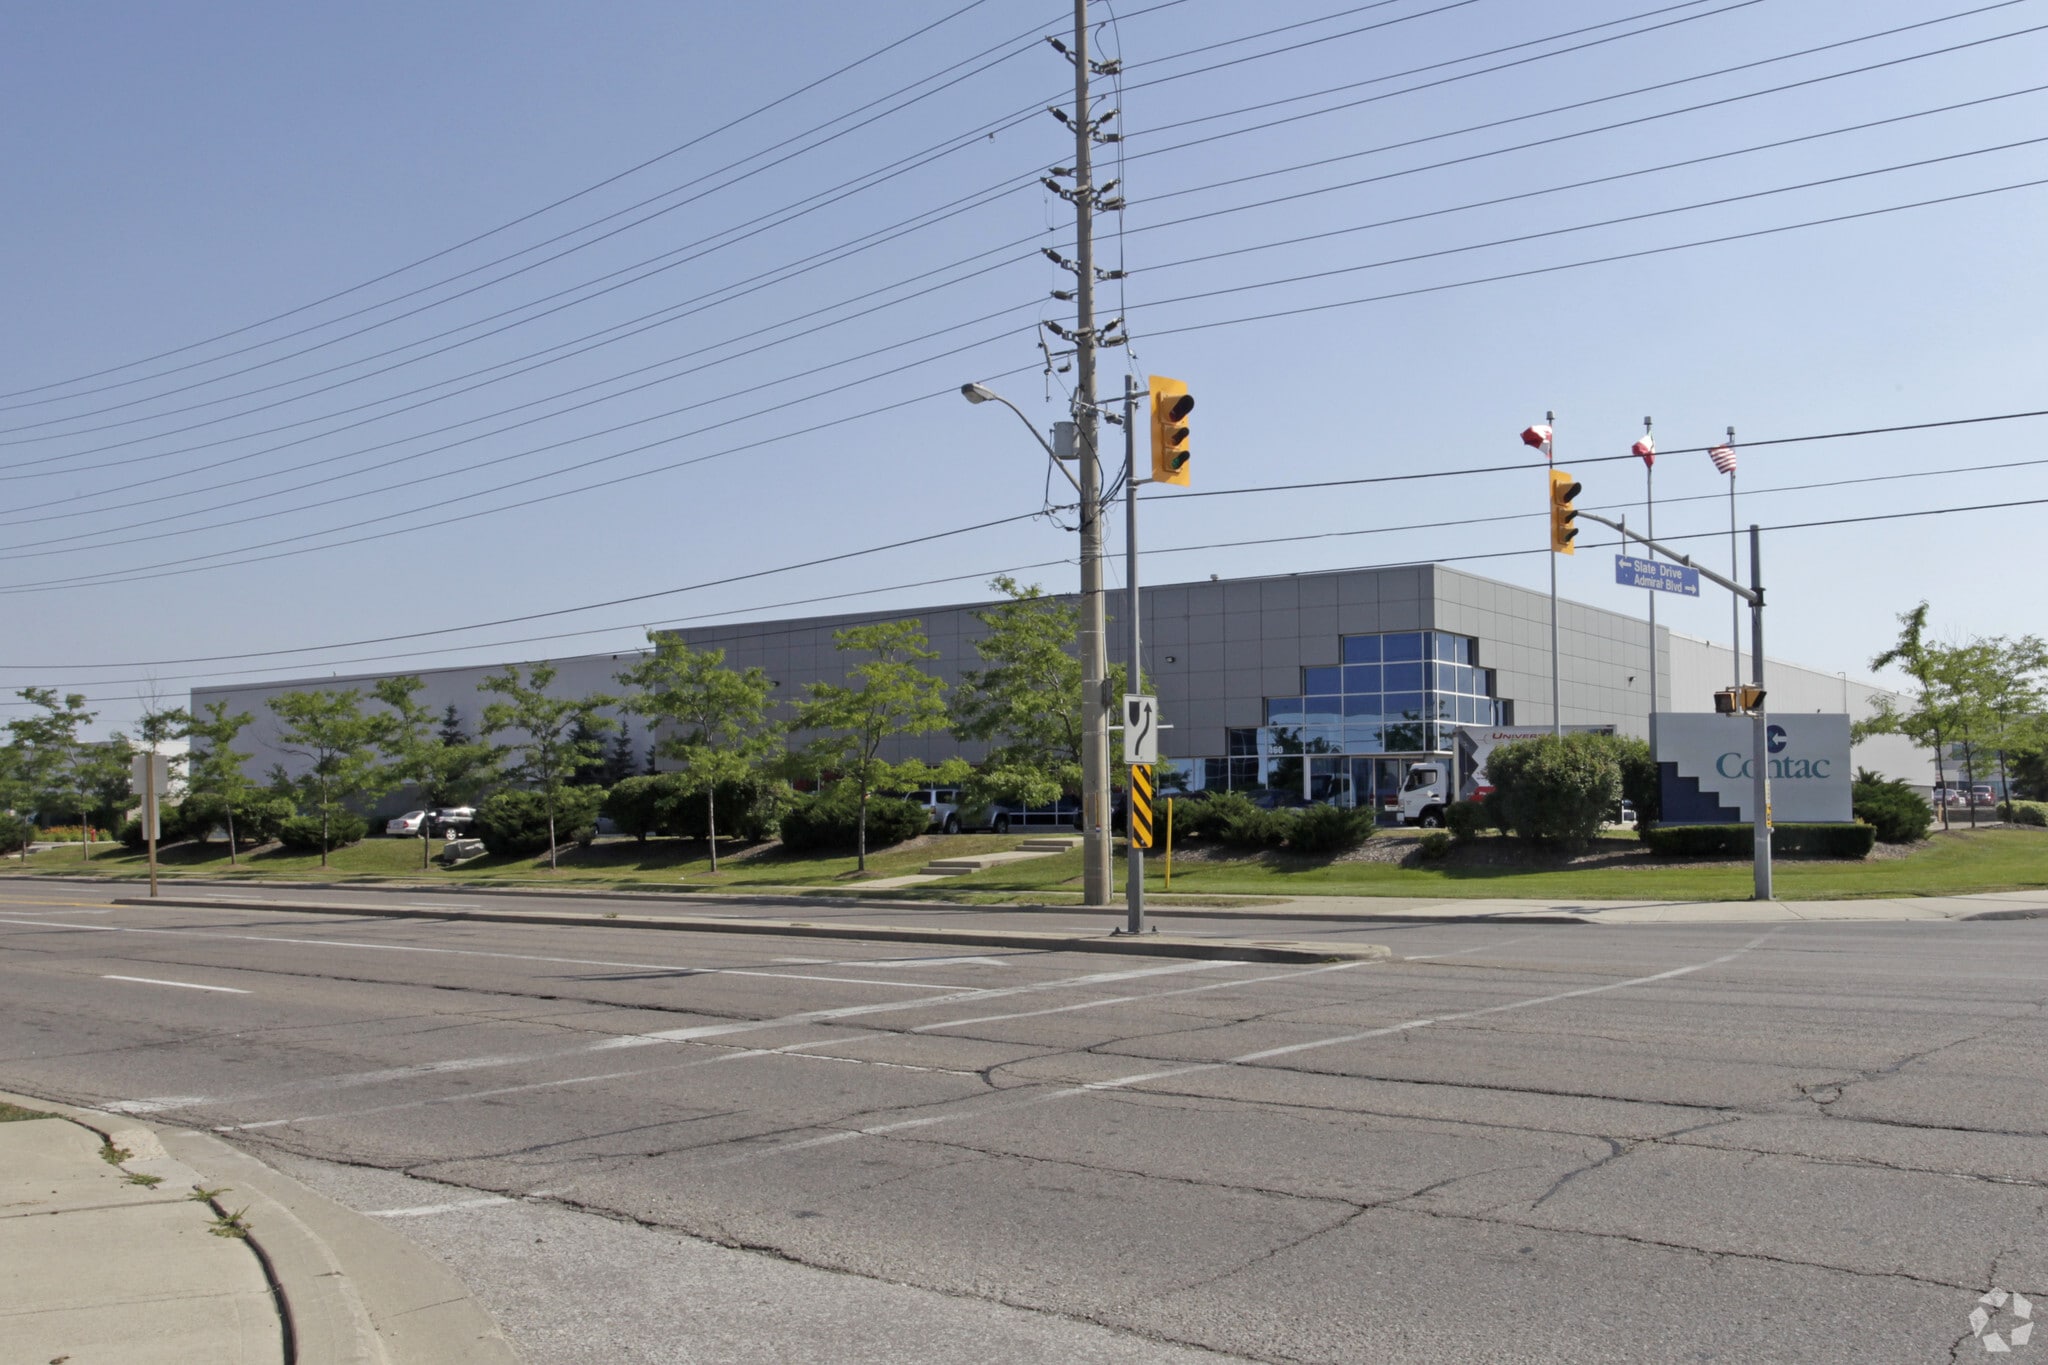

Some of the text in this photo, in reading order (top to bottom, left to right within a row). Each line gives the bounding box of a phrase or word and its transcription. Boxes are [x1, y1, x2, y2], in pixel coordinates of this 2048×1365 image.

[1634, 560, 1683, 579] Slate Drive
[1634, 574, 1683, 593] Admiral Blvd
